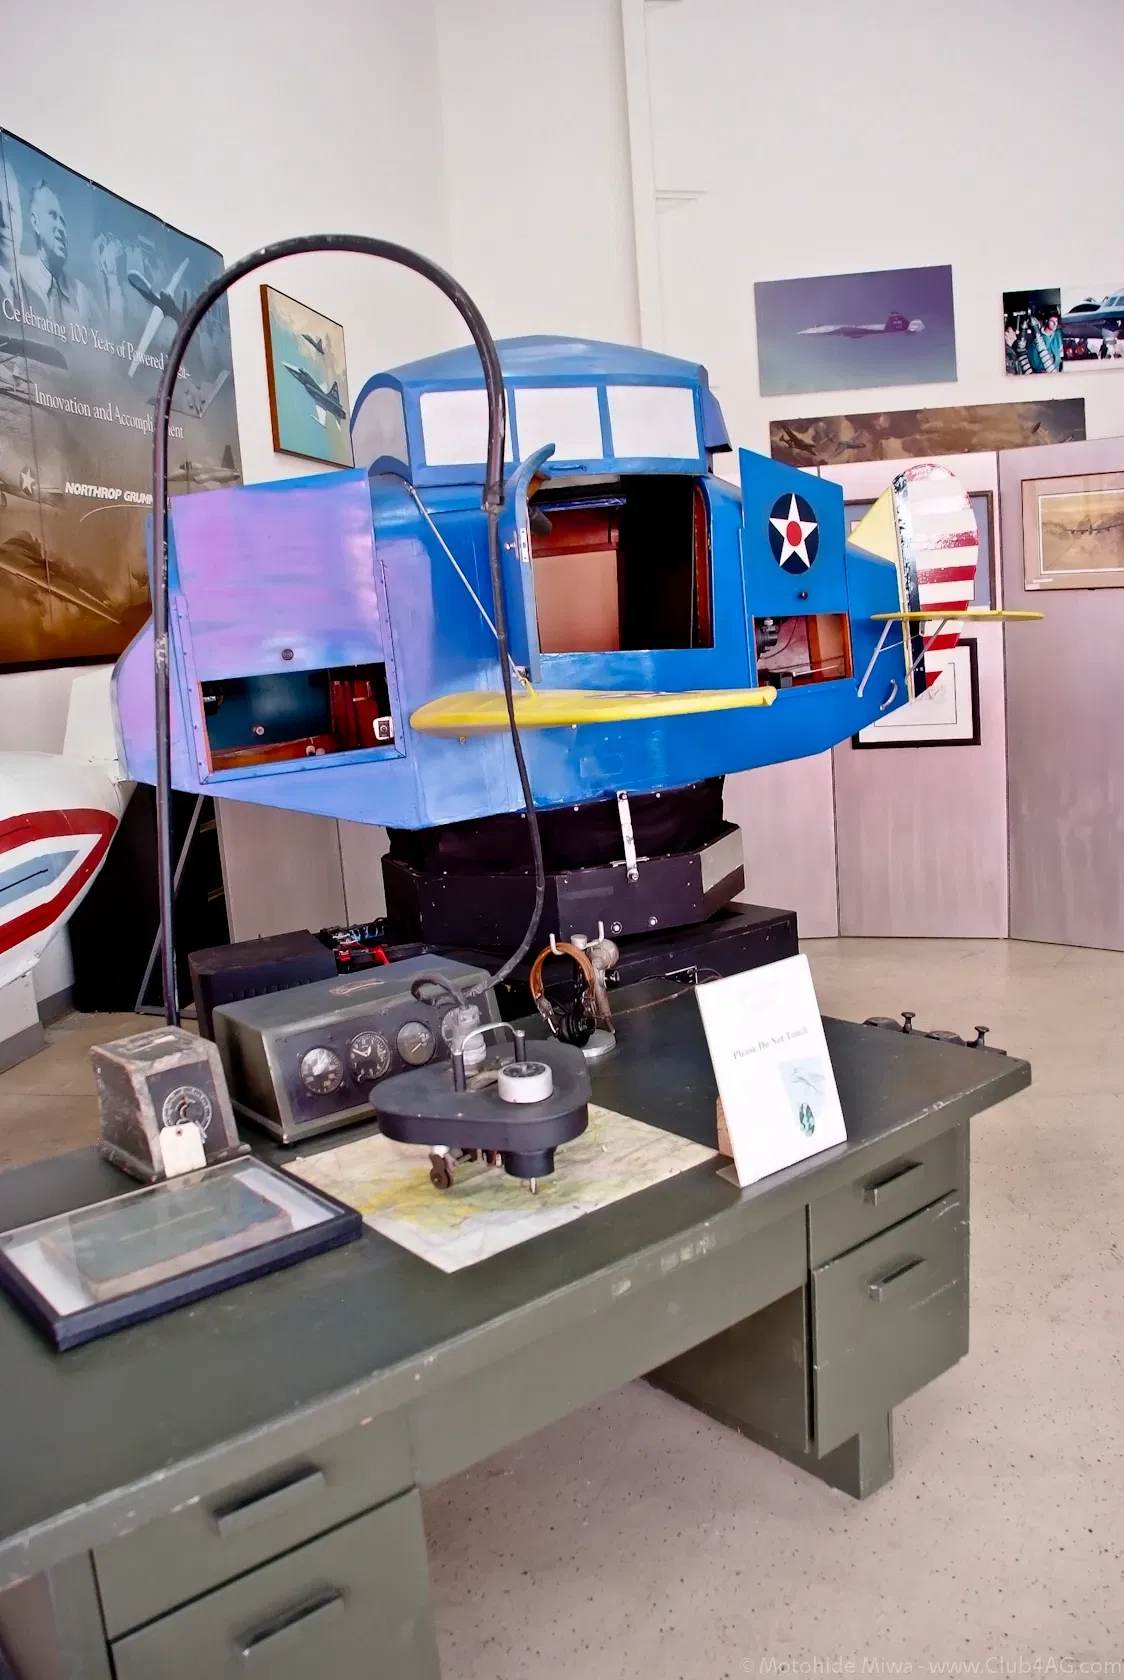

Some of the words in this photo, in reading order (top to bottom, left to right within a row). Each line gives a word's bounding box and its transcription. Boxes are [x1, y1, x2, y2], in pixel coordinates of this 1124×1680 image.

[3, 298, 67, 340] Celebrating
[70, 323, 88, 345] 100
[92, 330, 115, 354] Years
[116, 340, 127, 358] of
[127, 342, 165, 370] Powered
[35, 384, 91, 417] Innovation
[94, 405, 113, 422] and
[115, 406, 184, 439] Accomplient
[65, 481, 122, 500] NORTHROP
[732, 1047, 757, 1060] Please
[758, 1041, 770, 1050] Do
[770, 1036, 784, 1044] Not
[786, 1026, 808, 1040] Touch
